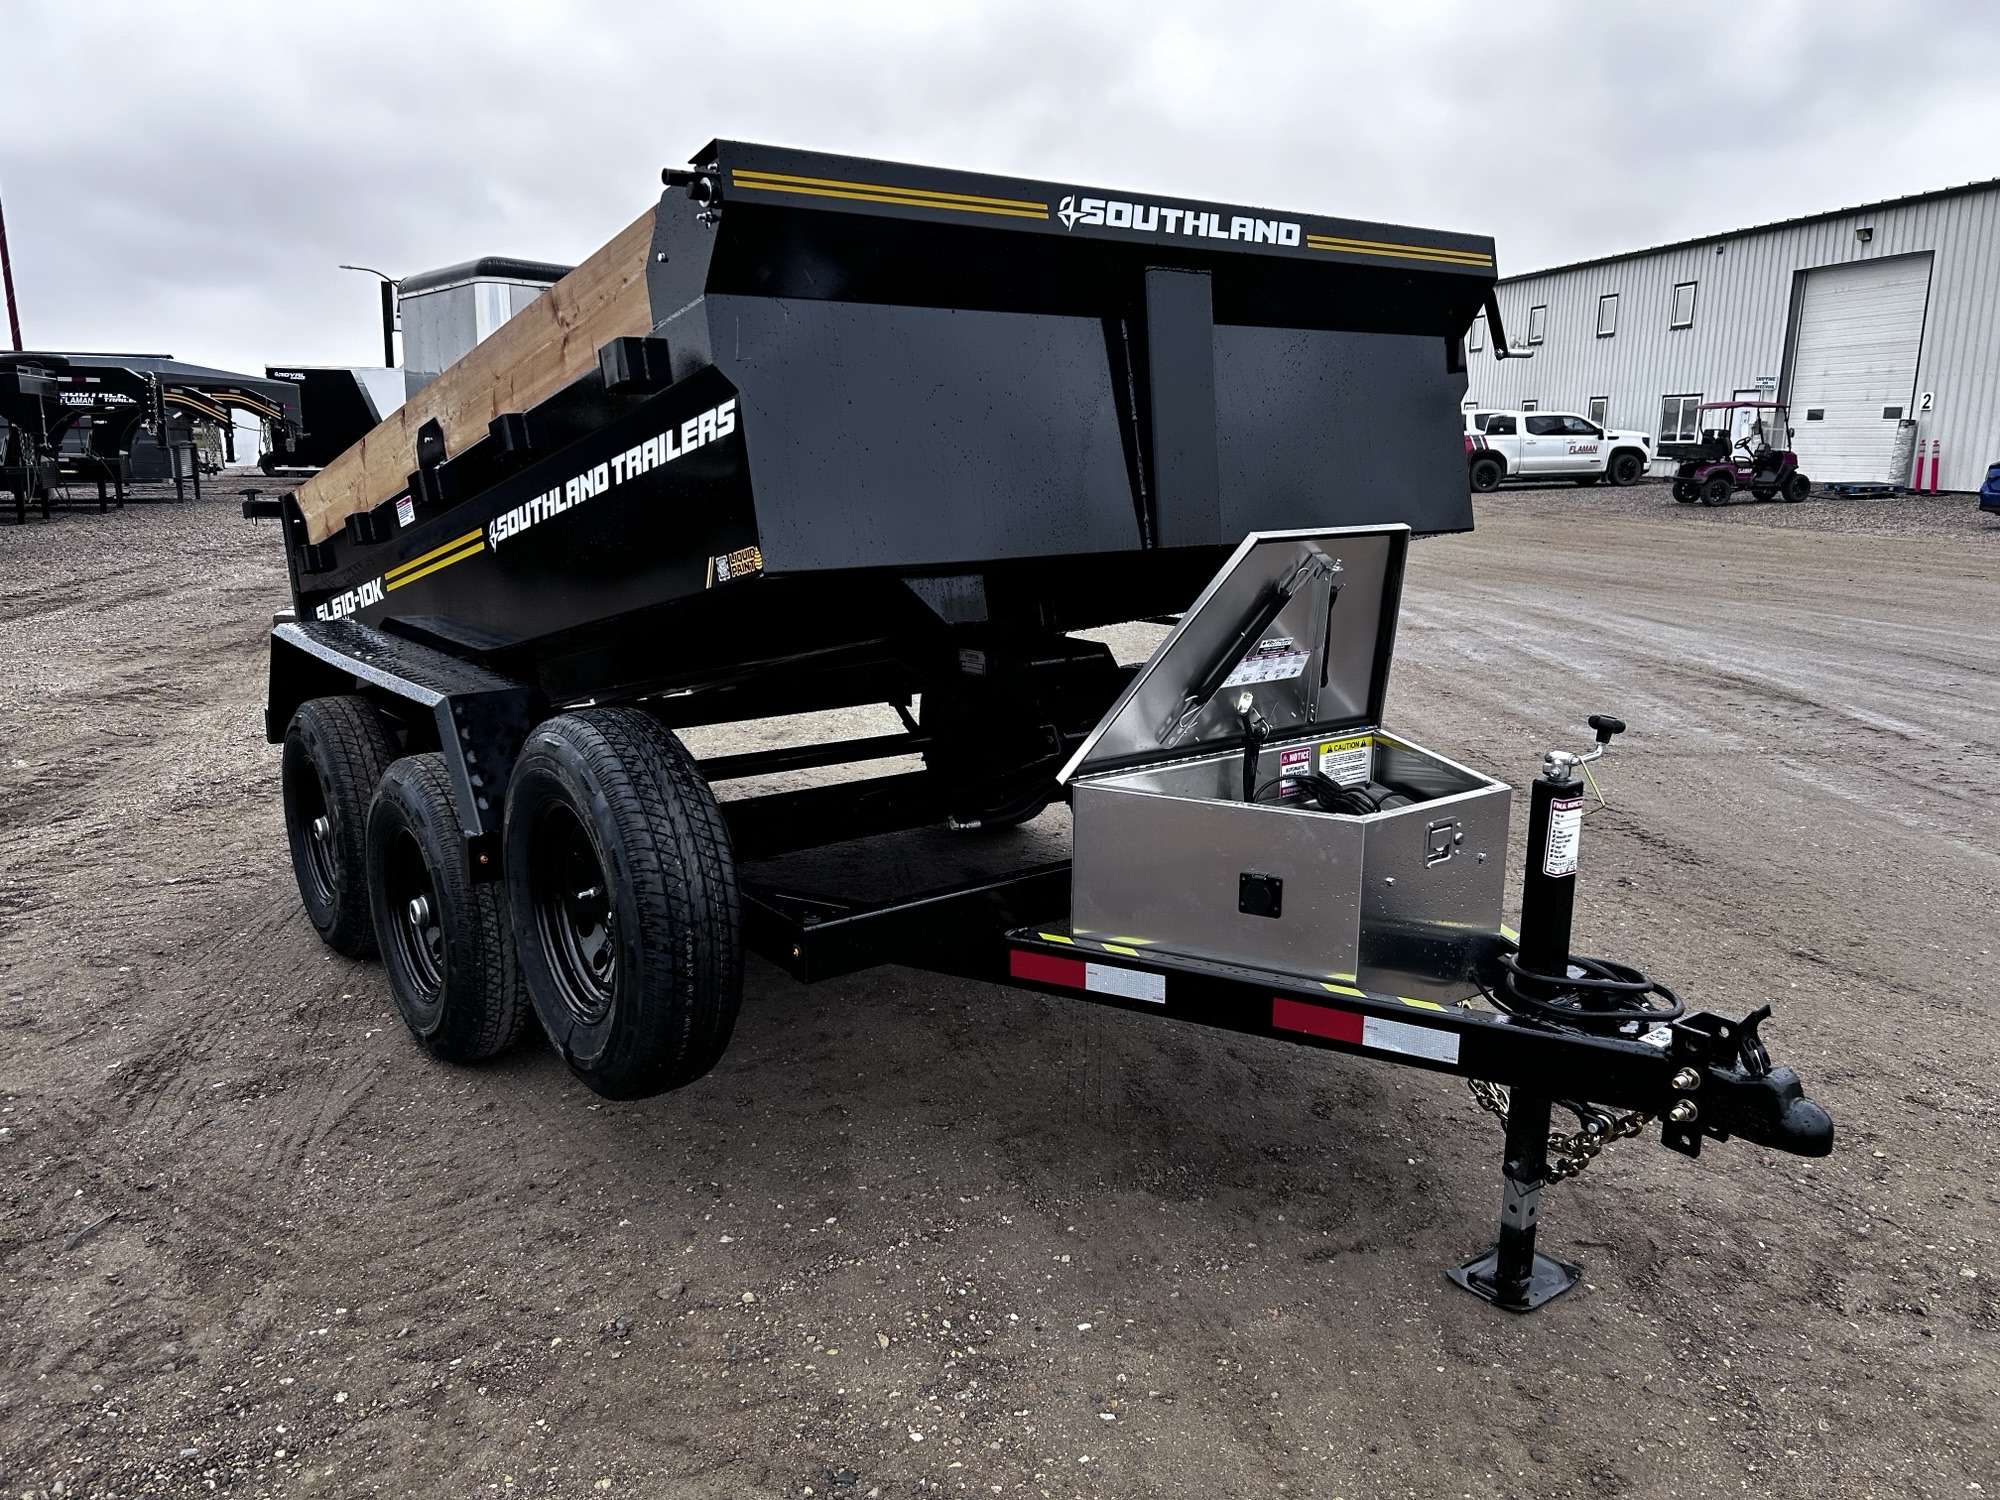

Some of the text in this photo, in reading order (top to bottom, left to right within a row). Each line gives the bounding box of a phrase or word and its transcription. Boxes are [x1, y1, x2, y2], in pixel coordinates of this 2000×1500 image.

[1080, 197, 1301, 247] SOUTHLAND
[1922, 393, 1932, 409] 2
[497, 398, 736, 542] SOUTHLAND TRAILERS
[1333, 740, 1360, 752] CAUTION
